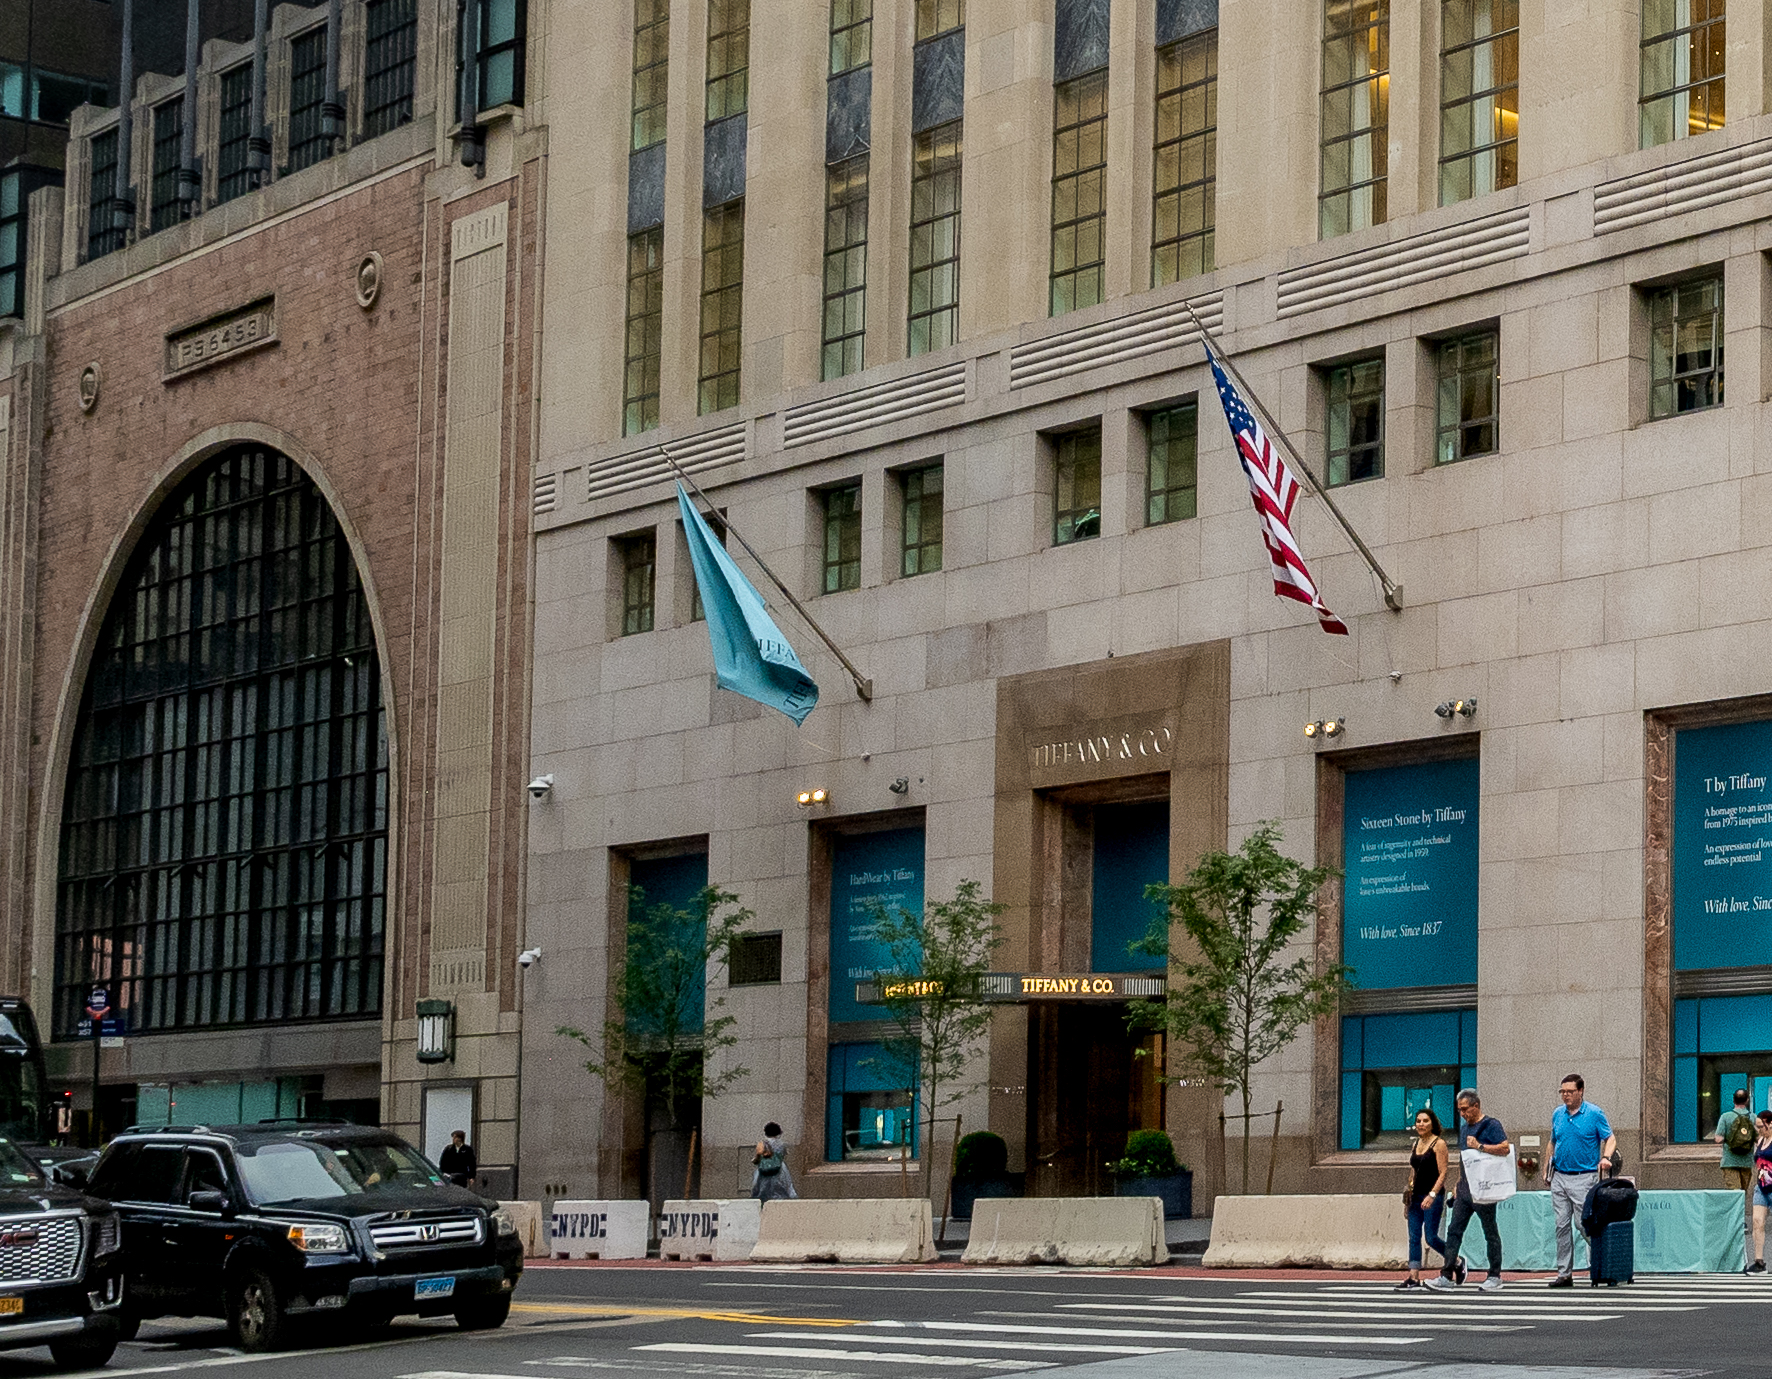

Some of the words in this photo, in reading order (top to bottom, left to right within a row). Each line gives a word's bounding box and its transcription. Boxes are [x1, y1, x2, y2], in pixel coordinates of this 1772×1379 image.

[1033, 737, 1114, 766] TIFFANY
[1704, 778, 1713, 793] T
[1714, 777, 1727, 796] by
[1729, 773, 1766, 792] Tiffany
[1360, 817, 1393, 830] Sixteen
[1395, 814, 1420, 826] Stone
[1422, 809, 1433, 827] by
[1434, 806, 1466, 824] Tiffany
[1711, 806, 1737, 816] homage
[1739, 805, 1747, 814] to
[1705, 819, 1720, 829] from
[1739, 813, 1767, 828] inspired
[1704, 844, 1714, 853] An
[1715, 842, 1751, 855] expression
[1752, 838, 1763, 848] of
[1704, 855, 1729, 866] endless
[1730, 851, 1762, 866] potential
[1704, 897, 1728, 914] With
[1360, 925, 1379, 939] With
[1400, 924, 1420, 937] Since
[1422, 921, 1442, 935] 1837
[1021, 978, 1079, 993] TIFFANY
[1081, 978, 1091, 993] &
[1092, 978, 1114, 993] CO.
[558, 1213, 600, 1237] NYPD
[668, 1213, 711, 1237] NYPD
